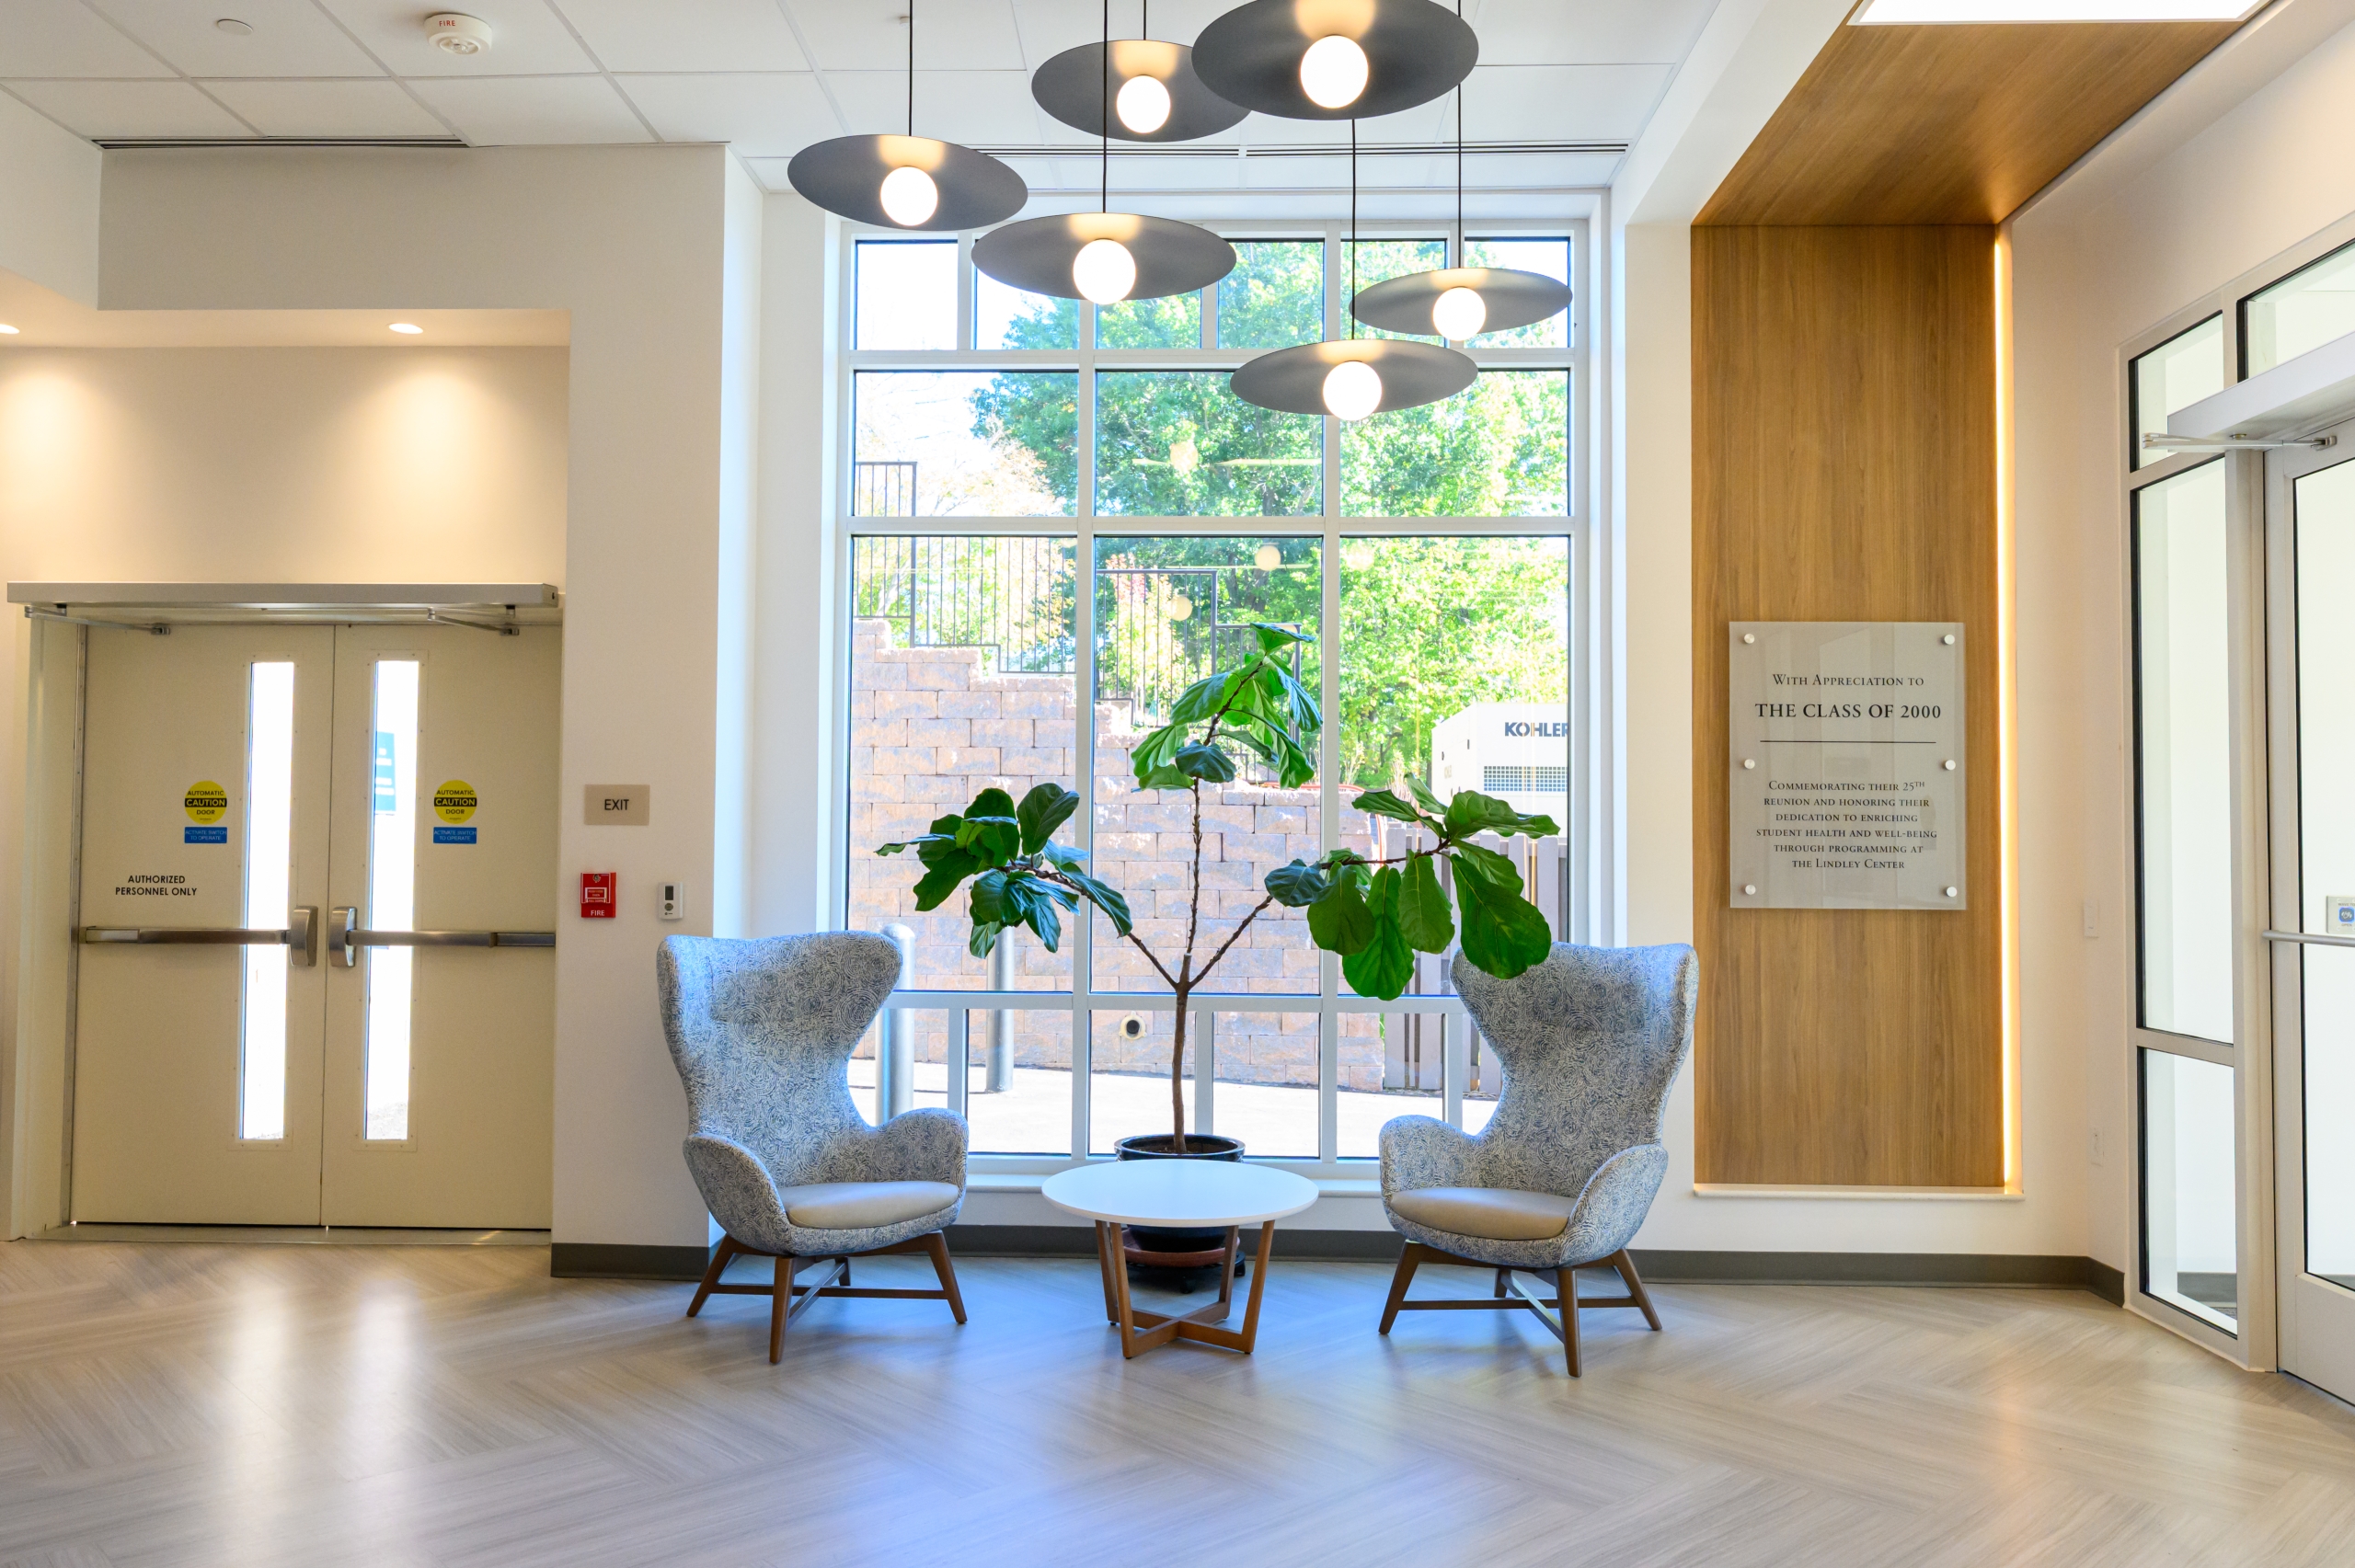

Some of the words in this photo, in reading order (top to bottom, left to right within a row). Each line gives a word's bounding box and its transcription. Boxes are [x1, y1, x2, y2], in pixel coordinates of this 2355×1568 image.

[1772, 674, 1808, 686] WITH
[1812, 674, 1904, 686] APPRECIATION
[1908, 677, 1924, 686] TO
[1755, 703, 1796, 717] THE
[1803, 704, 1861, 718] CLASS
[1868, 704, 1894, 718] OF
[1901, 705, 1941, 719] 2000
[1505, 722, 1568, 737] KOHLER
[1768, 780, 1866, 791] COMMEMORATING
[1869, 783, 1899, 791] THEIR
[604, 799, 629, 810] EXIT
[1764, 798, 1810, 806] REUNION
[1839, 798, 1895, 807] HONORING
[1776, 813, 1840, 821] DEDICATION
[1861, 814, 1918, 822] ENRICHING
[1849, 829, 1871, 837] AND
[1875, 829, 1937, 838] WELL-BEING
[1774, 844, 1824, 852] THROUGH
[1829, 845, 1907, 853] PROGRAMMING
[1815, 858, 1861, 868] LINDLEY
[1864, 859, 1905, 869] CENTER
[115, 887, 168, 895] PERSONNEL
[172, 887, 197, 895] ONLY
